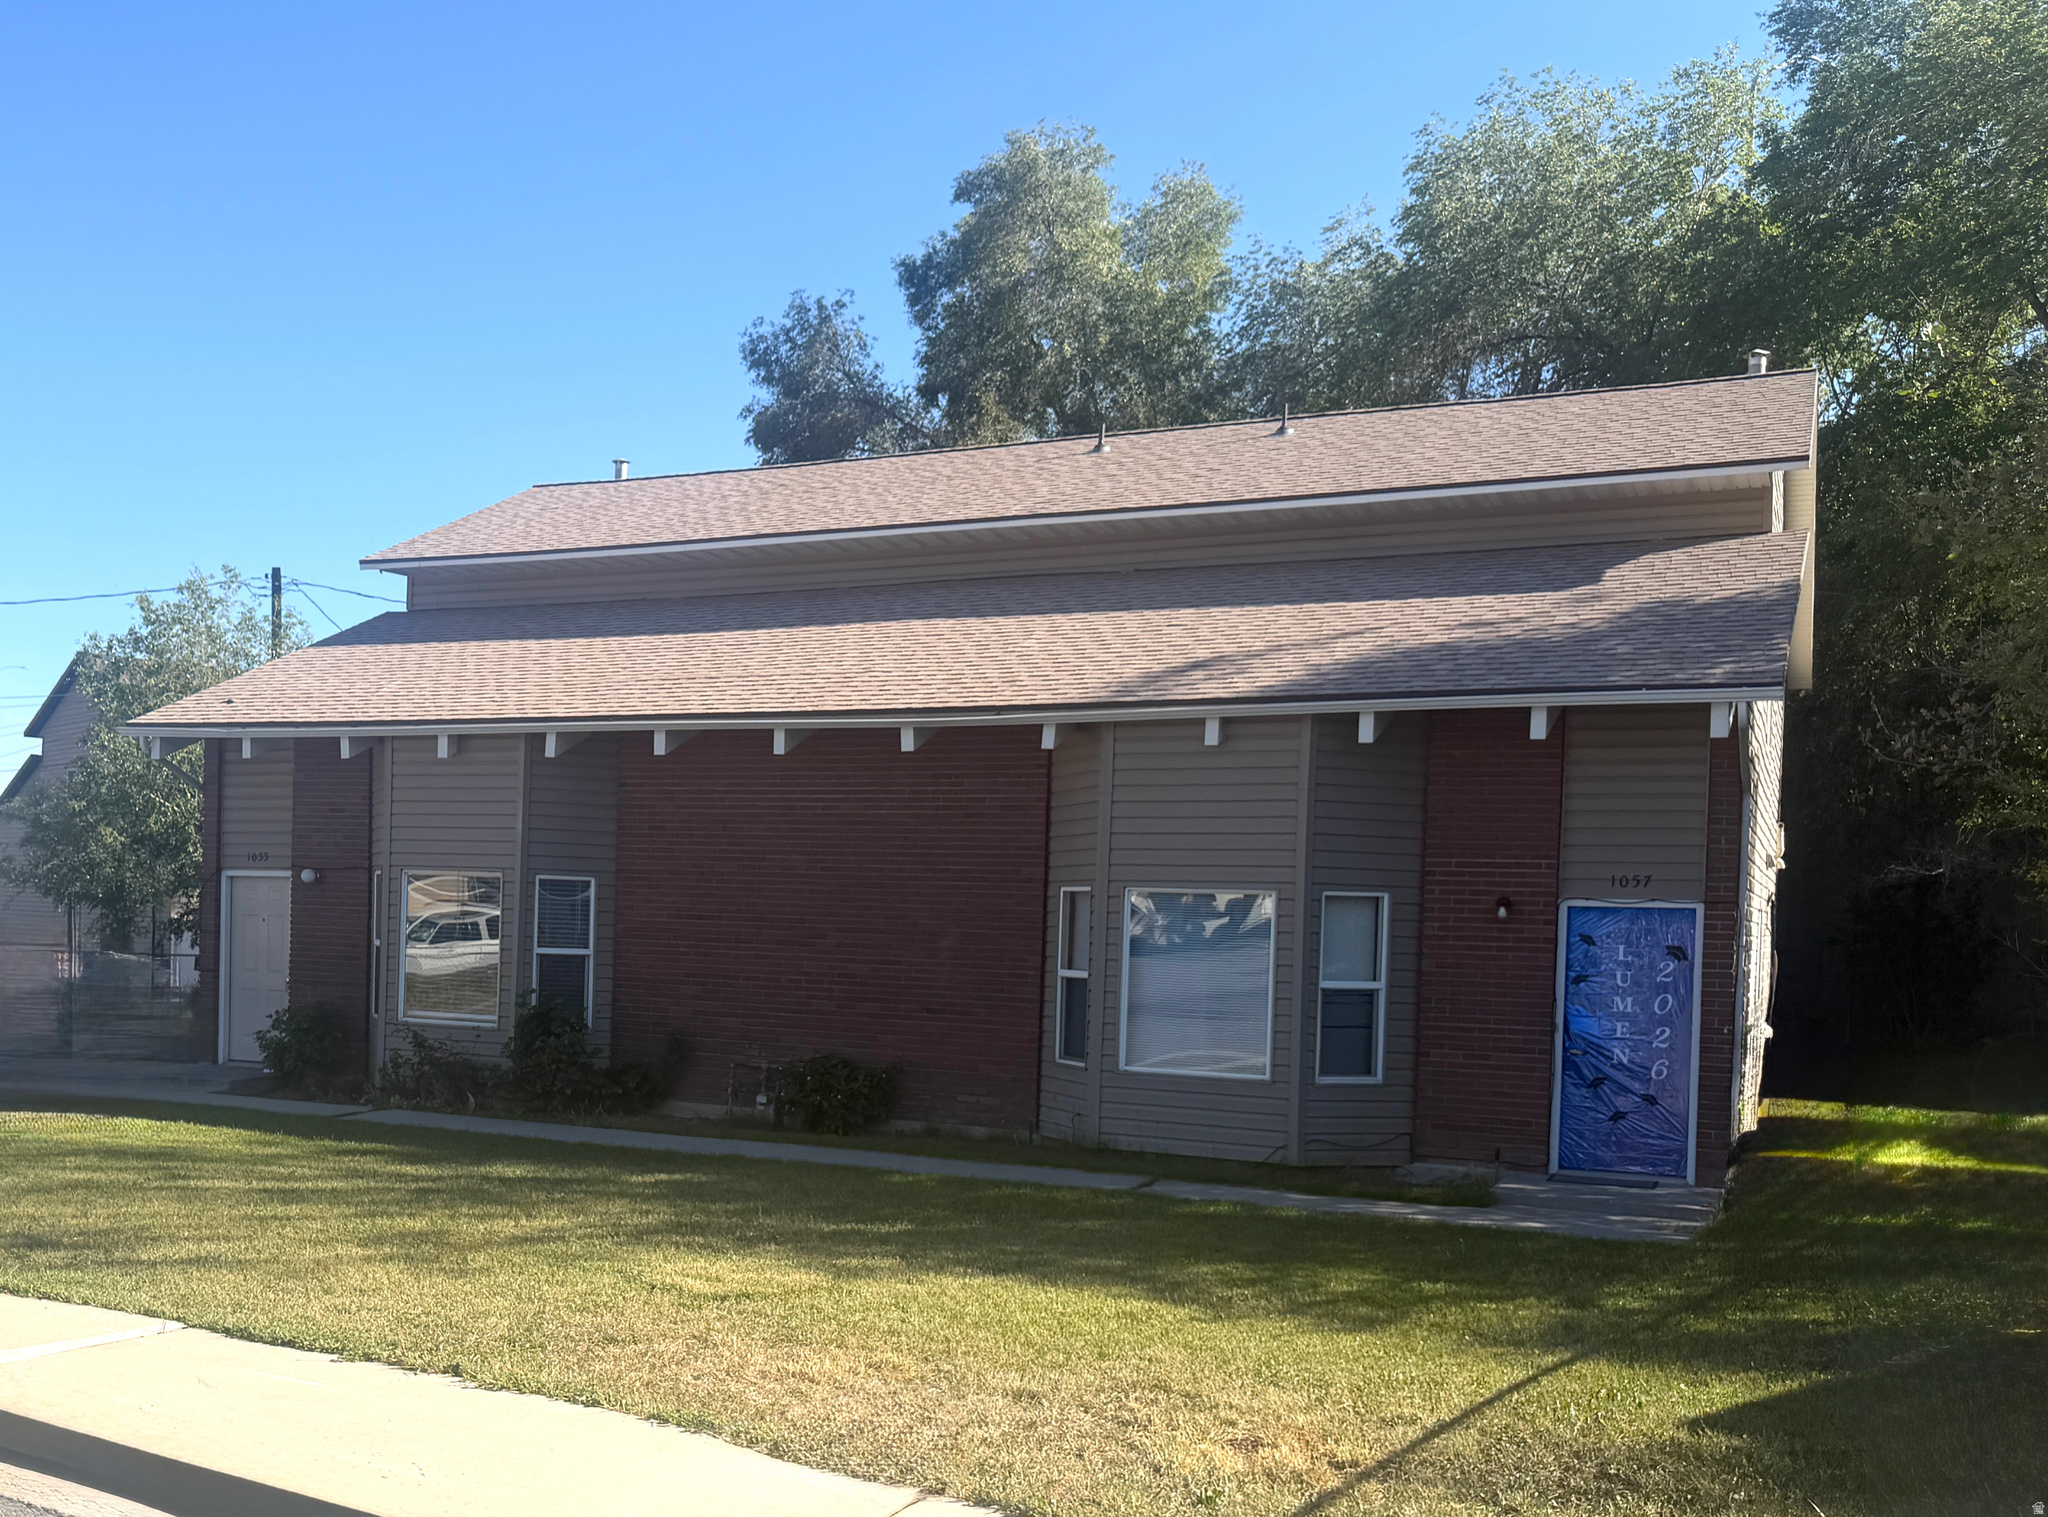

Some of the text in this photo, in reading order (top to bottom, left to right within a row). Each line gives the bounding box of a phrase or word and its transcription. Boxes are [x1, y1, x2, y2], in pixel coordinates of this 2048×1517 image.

[247, 851, 269, 862] 1055
[1611, 874, 1653, 888] 1057
[1611, 944, 1634, 1065] LUMEN
[1651, 961, 1675, 1080] 2026
